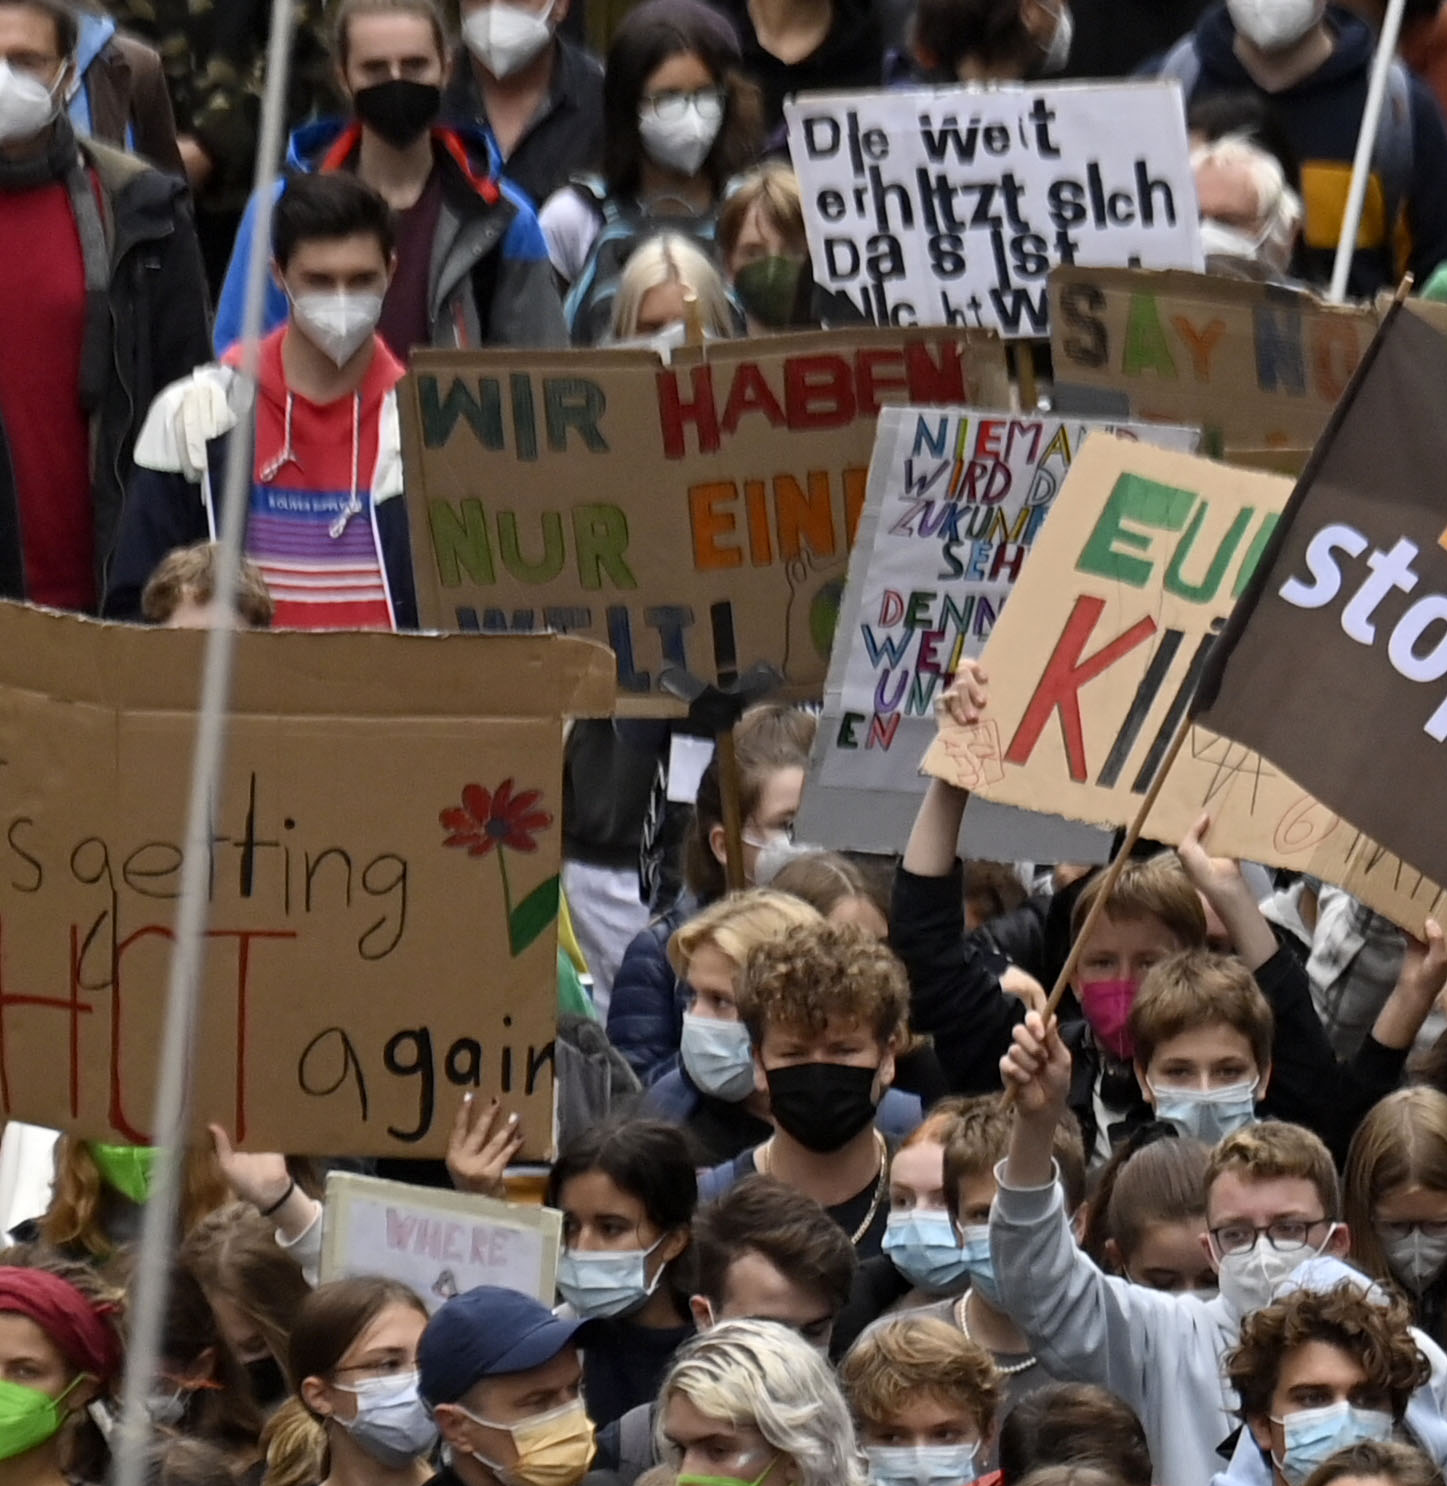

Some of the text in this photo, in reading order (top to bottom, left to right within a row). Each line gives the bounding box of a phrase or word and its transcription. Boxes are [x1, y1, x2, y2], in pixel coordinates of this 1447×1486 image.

[416, 337, 967, 462] WIR HABEN
[904, 458, 1014, 505] WIRD
[427, 497, 638, 590] NUR
[385, 1206, 515, 1267] WHERE
